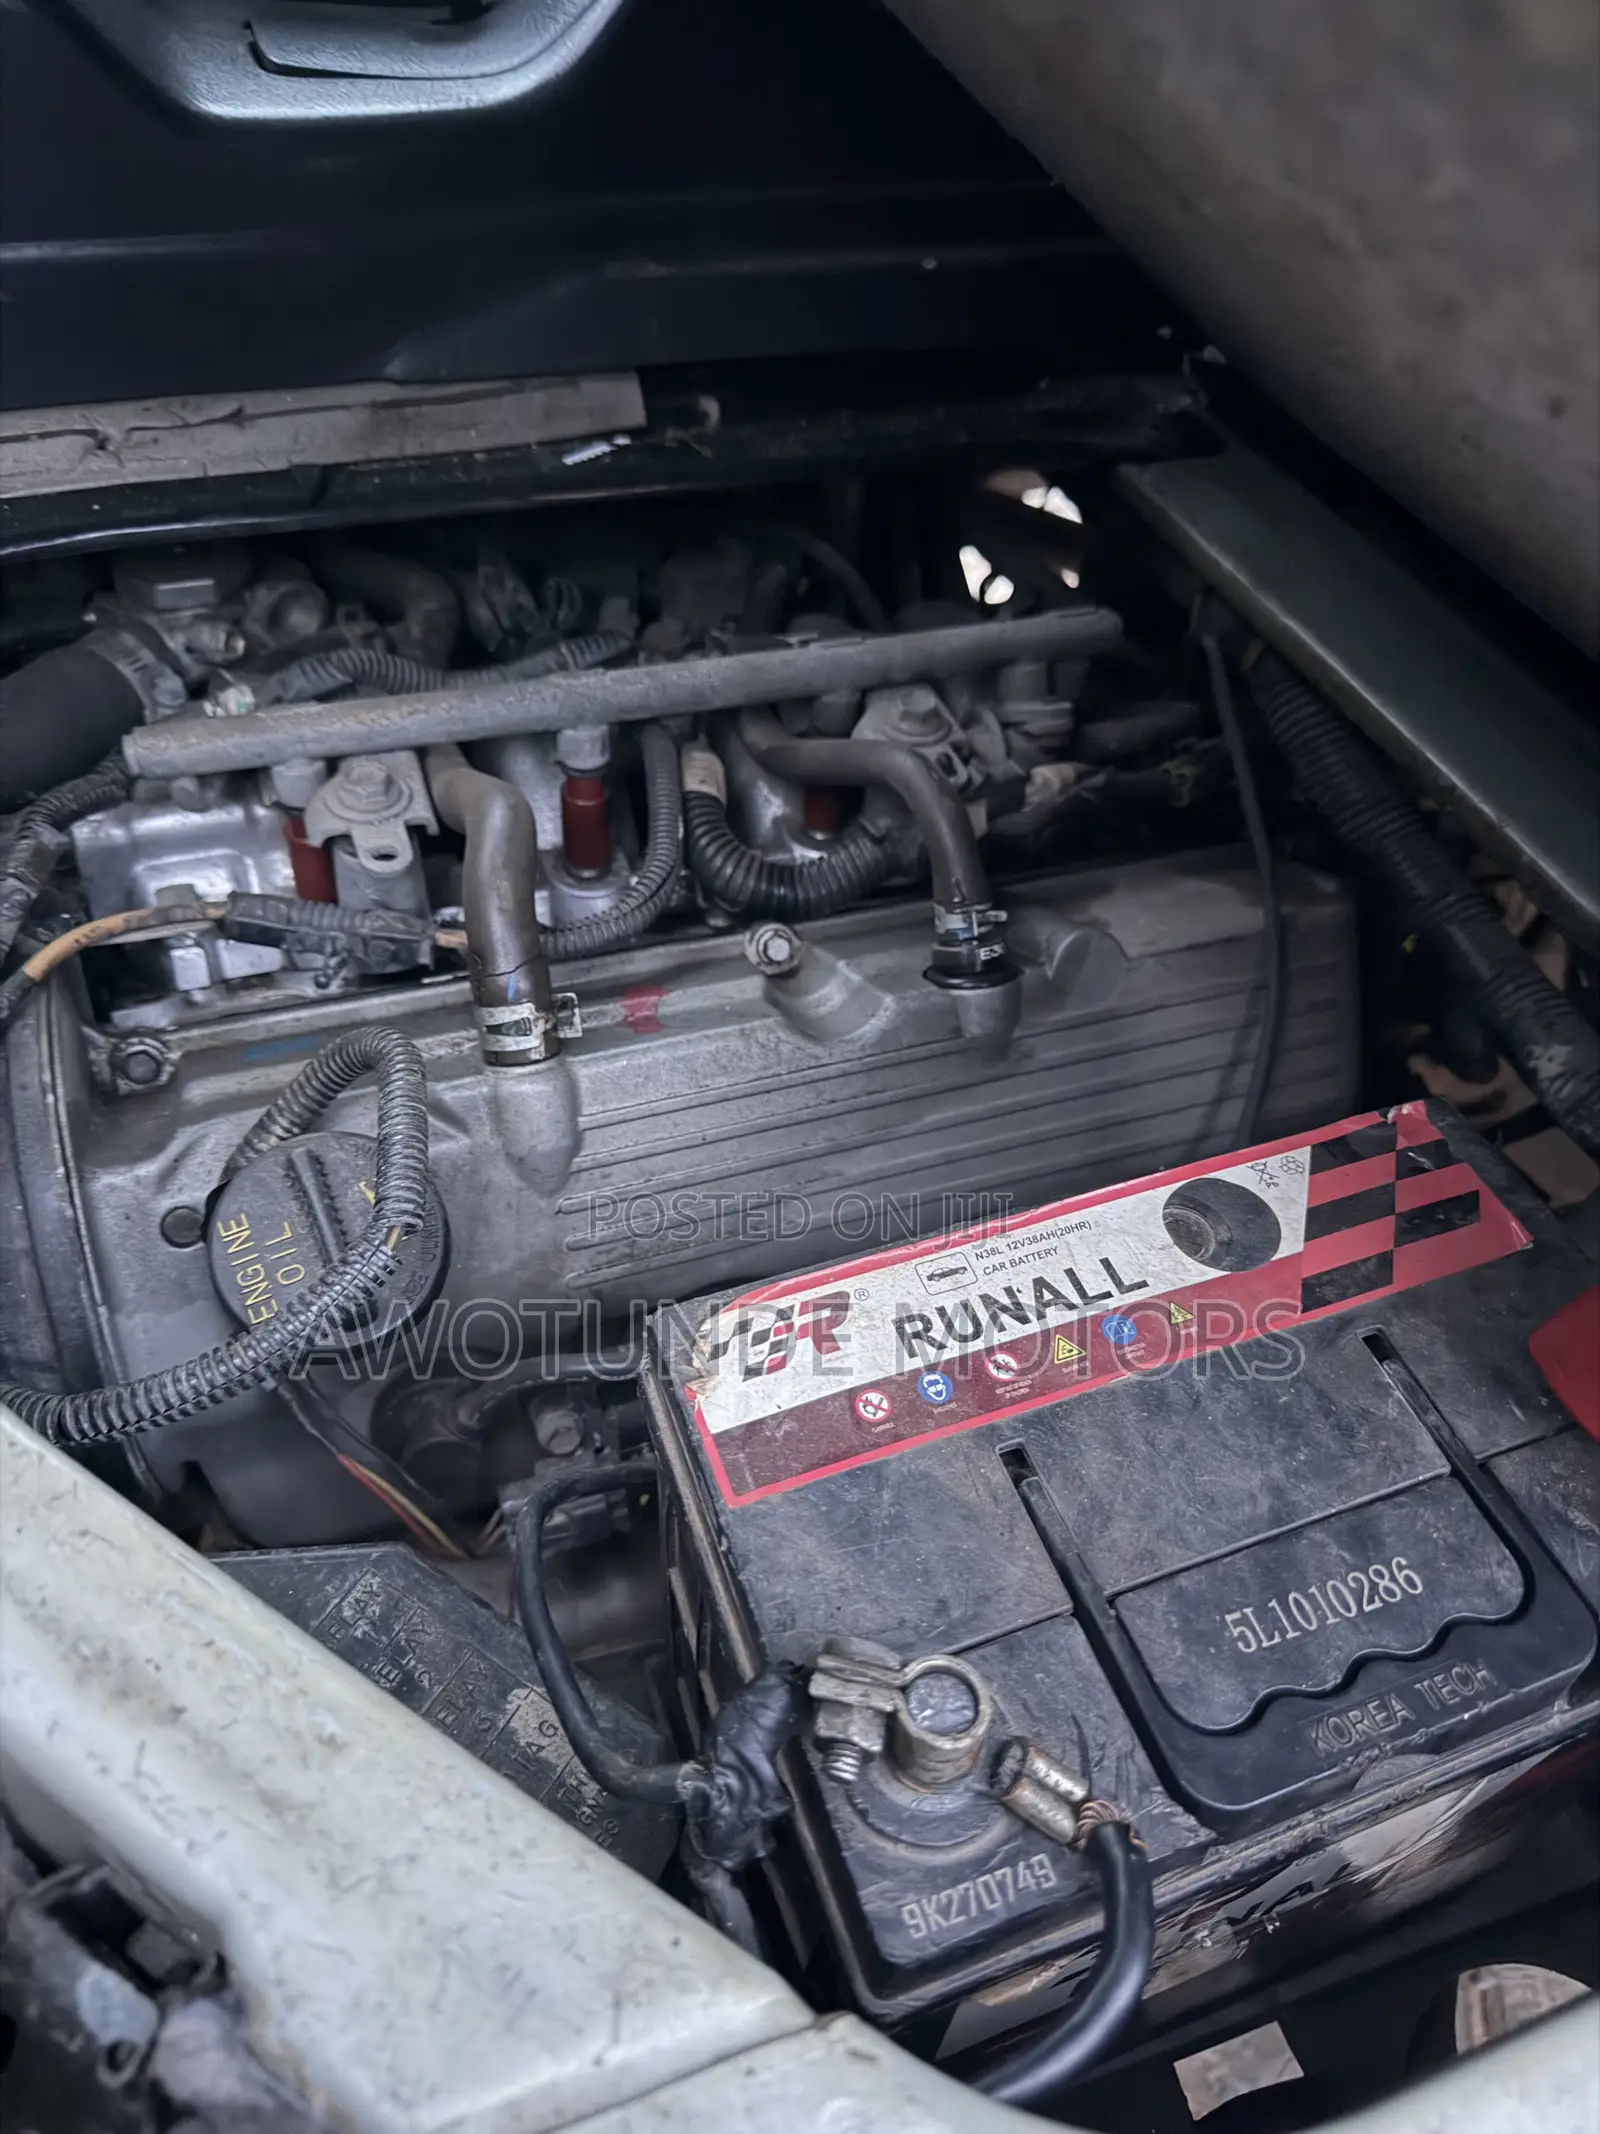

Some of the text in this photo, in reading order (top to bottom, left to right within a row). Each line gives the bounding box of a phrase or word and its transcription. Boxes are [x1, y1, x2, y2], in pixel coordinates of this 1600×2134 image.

[215, 1212, 280, 1326] ENGINE
[263, 1220, 306, 1286] OIL
[974, 1220, 1092, 1261] N38L 12V38AH(20HR)
[983, 1246, 1059, 1276] CAR BATTERY
[890, 1256, 1150, 1360] RUNALL
[324, 1581, 383, 1645] ELAY
[1223, 1556, 1424, 1654] 5L1010286
[373, 1619, 433, 1684] ELAY
[1306, 1659, 1498, 1757] KOREA TECH
[900, 1852, 1058, 1939] 9K270749
